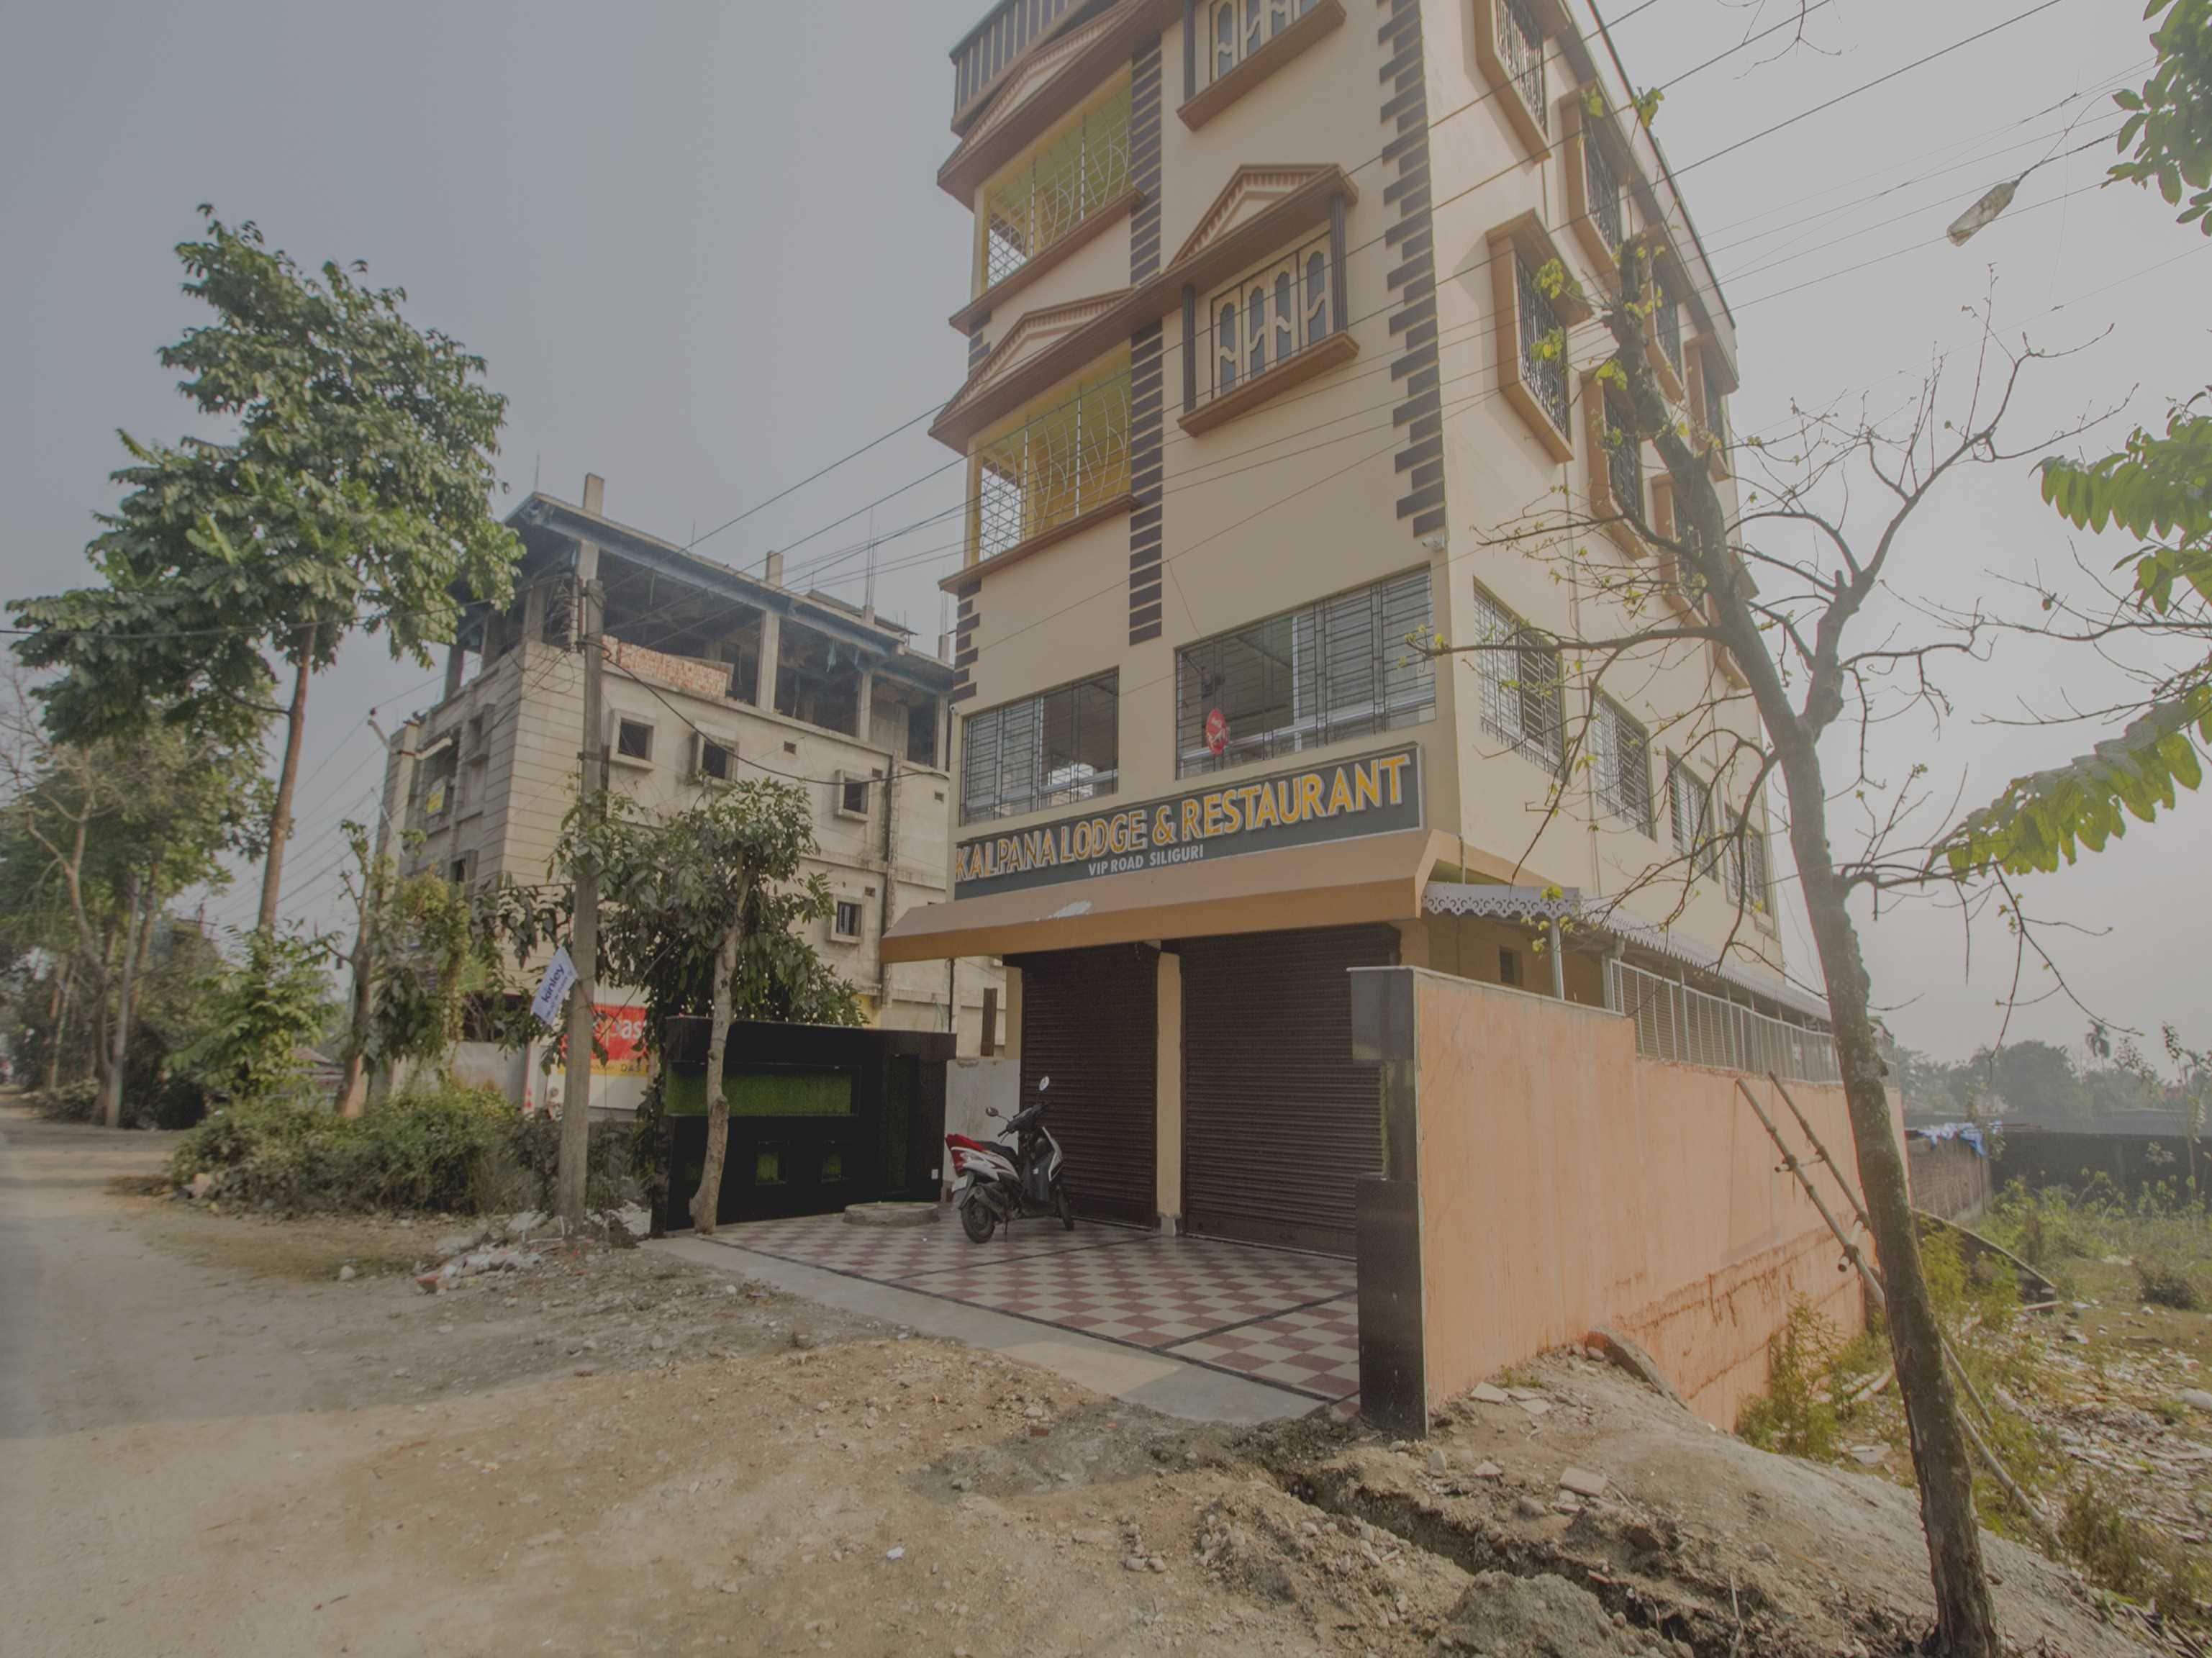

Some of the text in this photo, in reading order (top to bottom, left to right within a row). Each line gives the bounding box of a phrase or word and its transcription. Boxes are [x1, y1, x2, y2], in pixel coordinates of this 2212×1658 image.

[955, 754, 1410, 882] KALPANA LODGE & RESTAURANT
[1088, 843, 1205, 876] VIP ROAD SILIGURI
